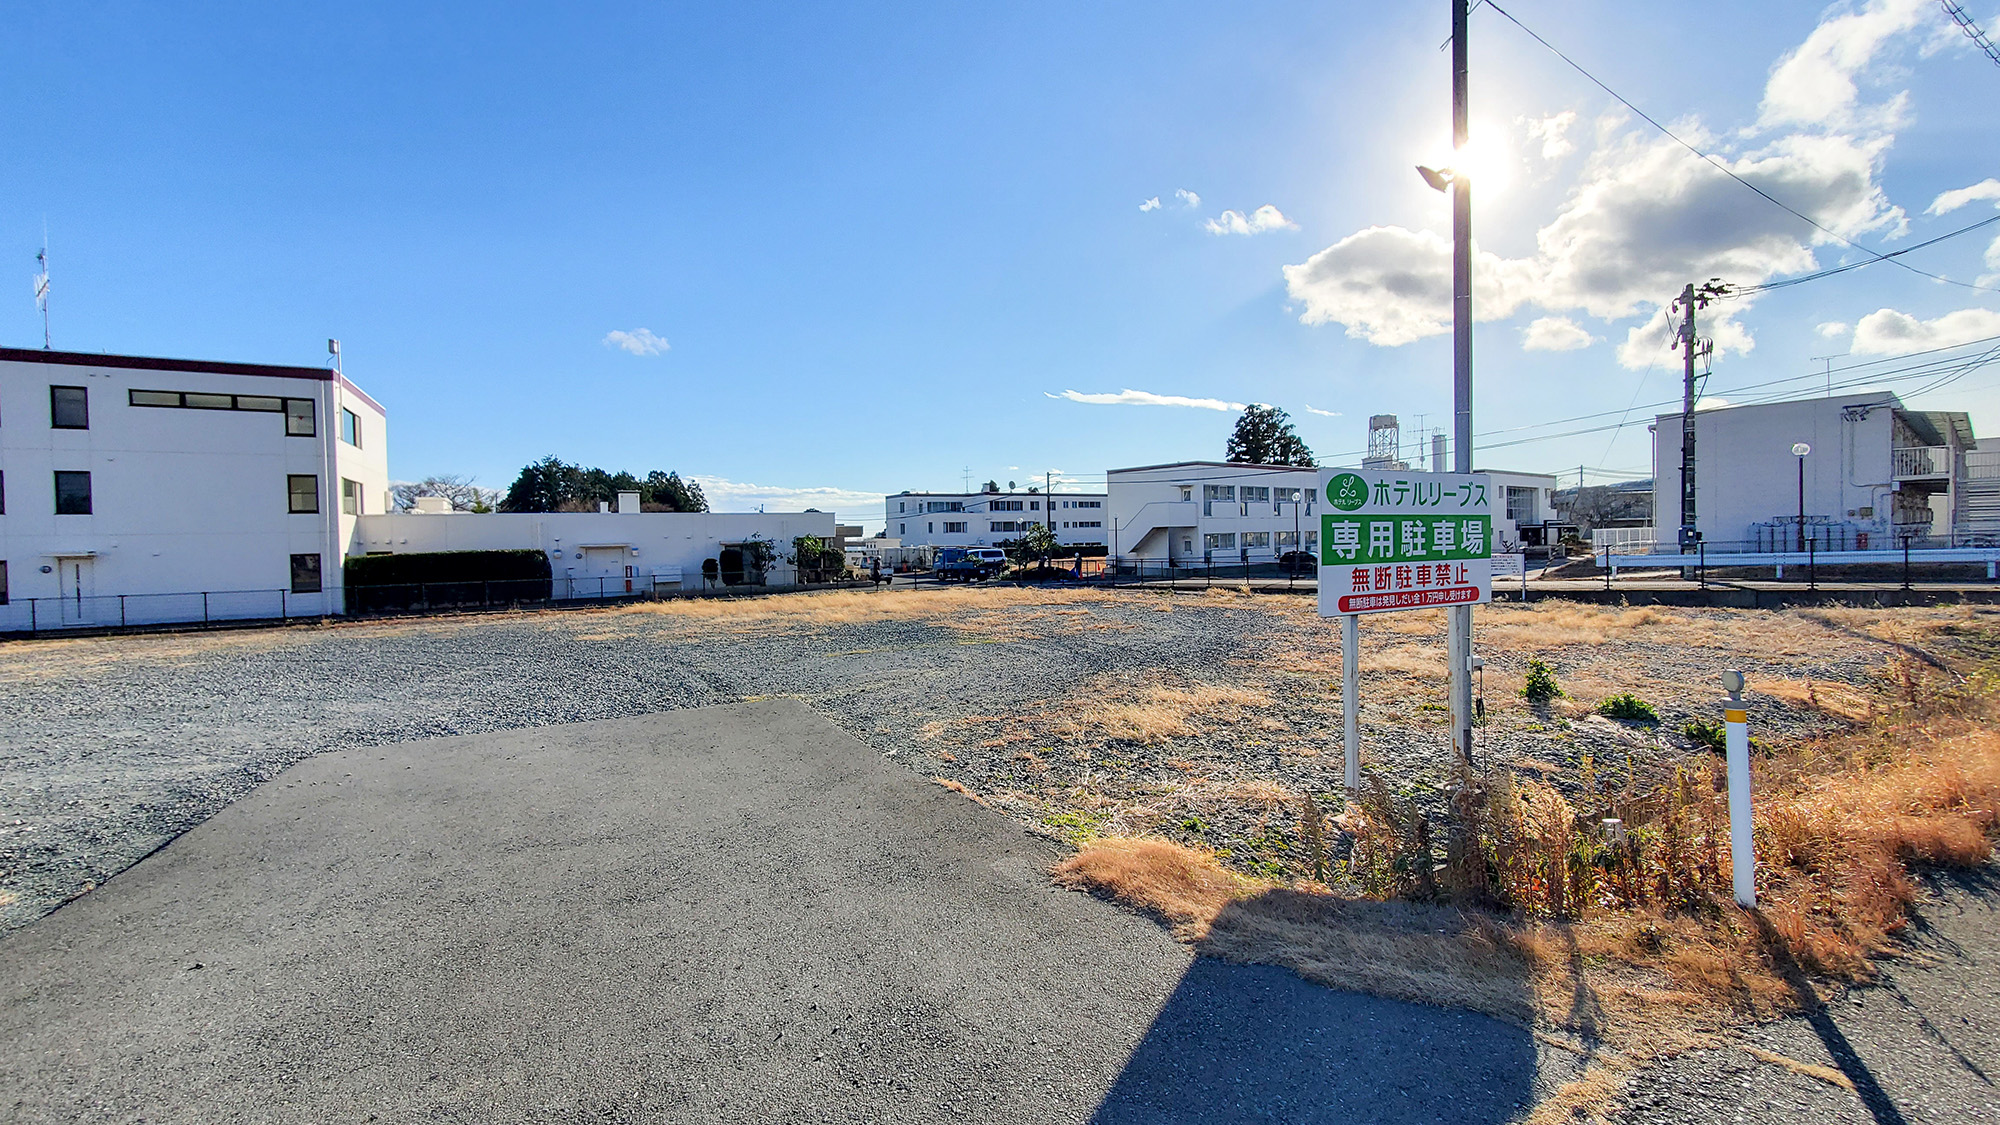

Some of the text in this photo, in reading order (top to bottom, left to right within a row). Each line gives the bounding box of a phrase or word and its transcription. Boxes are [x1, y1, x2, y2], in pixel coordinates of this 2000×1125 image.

[1373, 479, 1488, 507] ホテルリーブス
[1331, 519, 1484, 560] 専用駐車場
[1351, 562, 1469, 593] 無断駐車禁止
